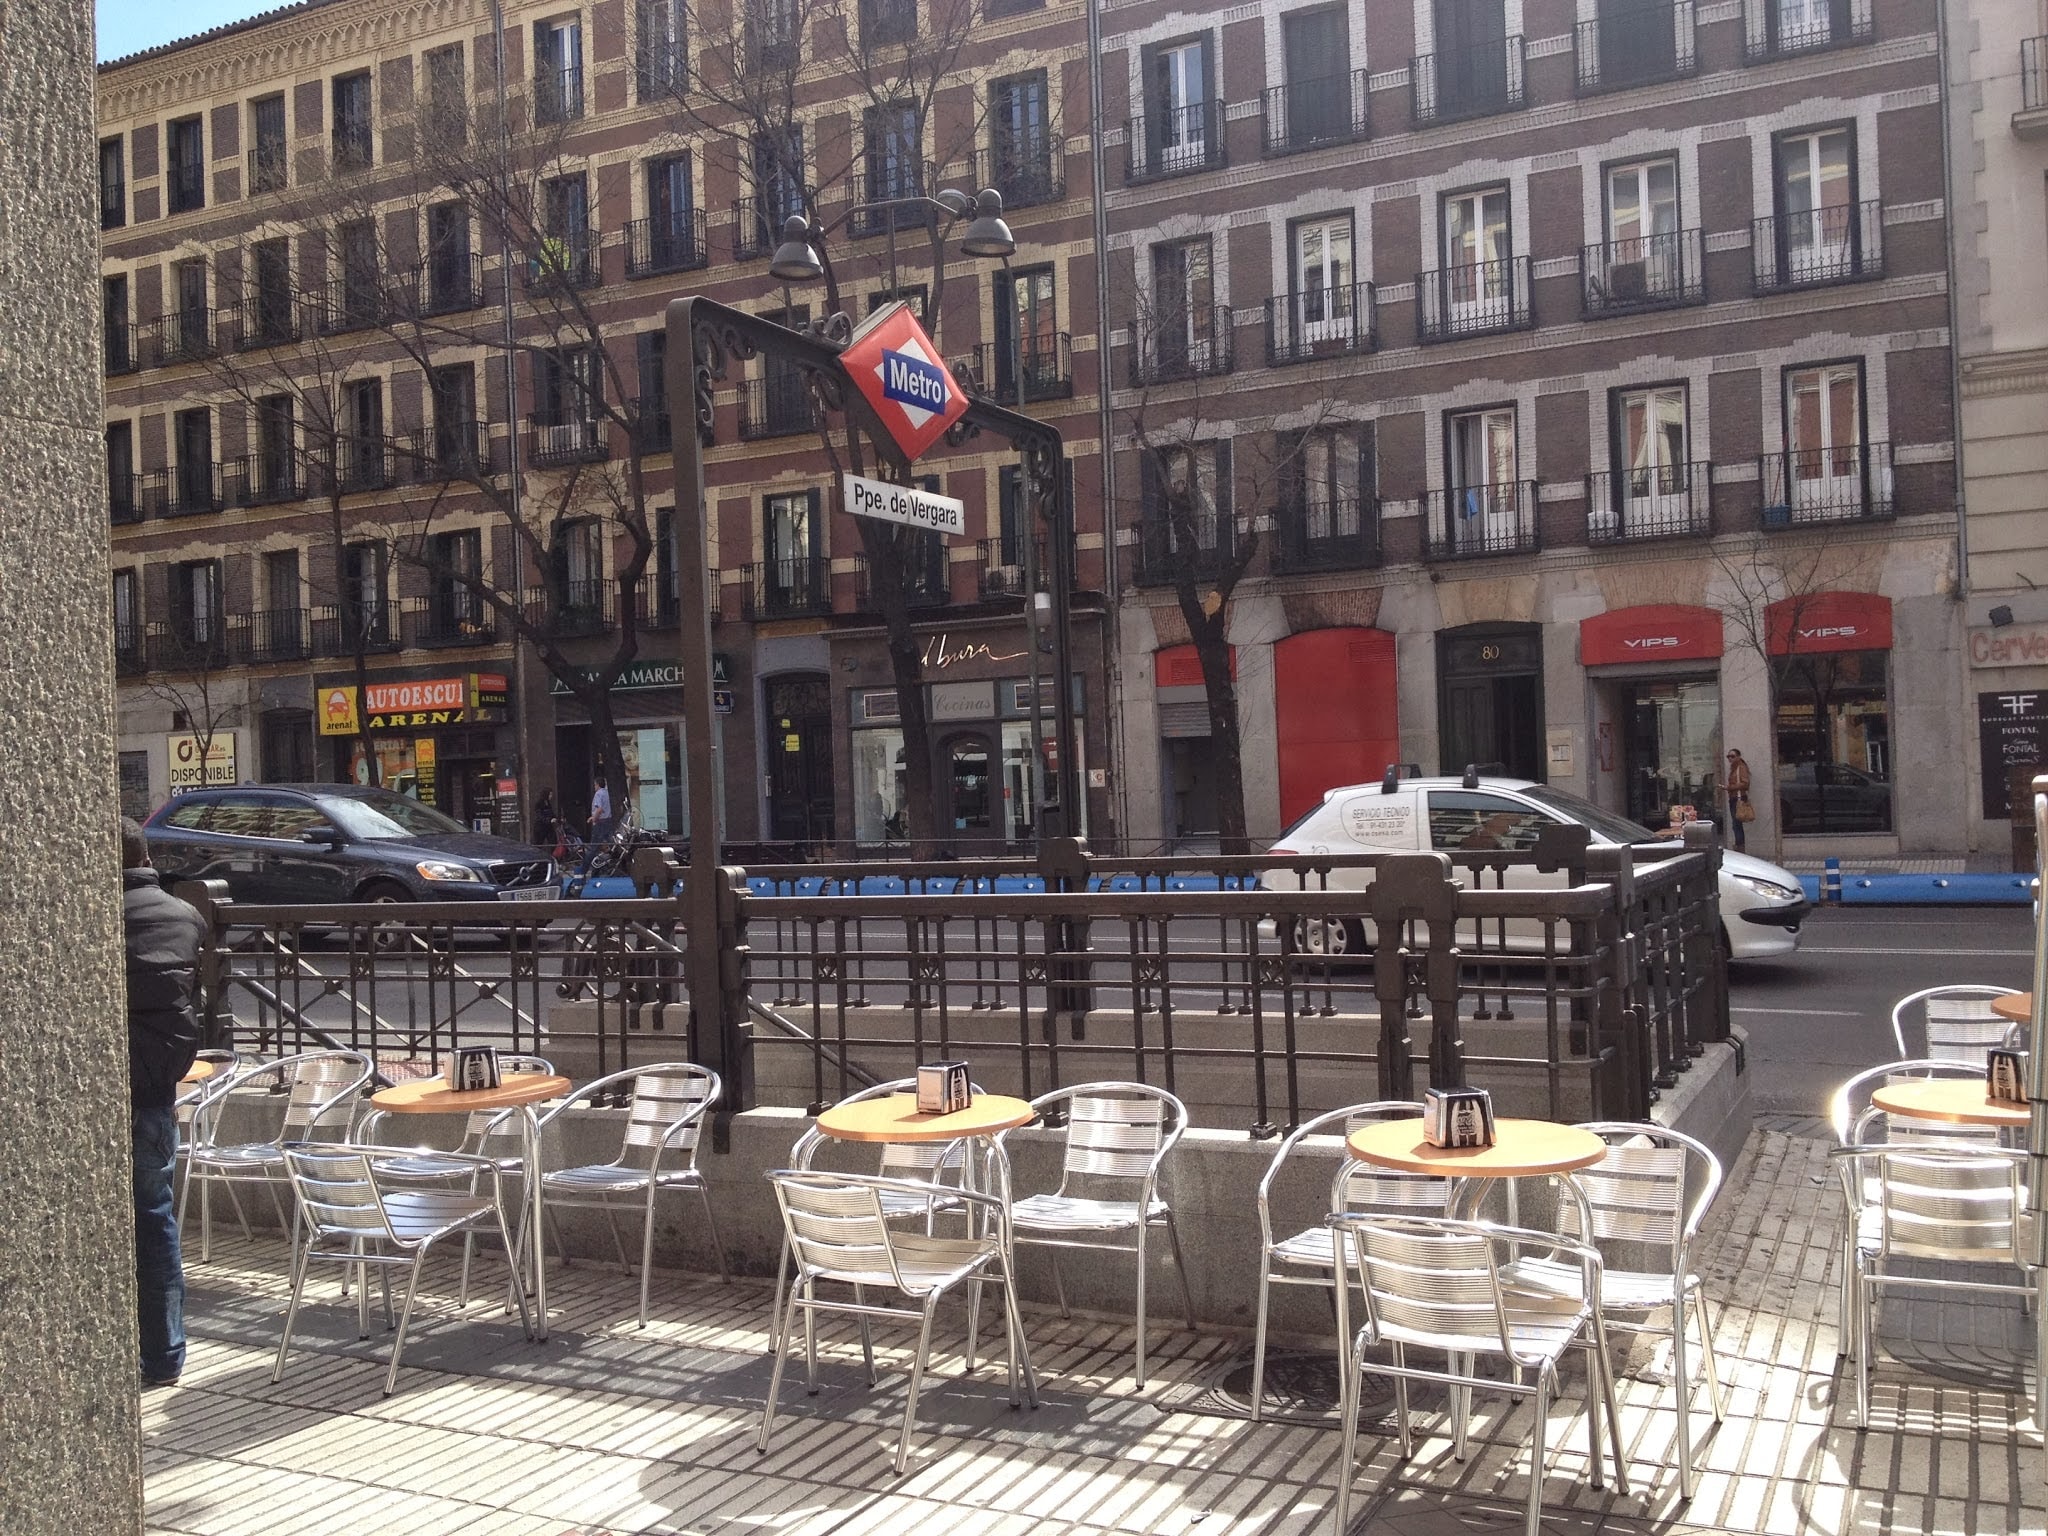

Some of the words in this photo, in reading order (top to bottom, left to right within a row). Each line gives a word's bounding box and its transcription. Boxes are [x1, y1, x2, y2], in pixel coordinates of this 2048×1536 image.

[890, 358, 941, 404] Metro
[854, 483, 886, 512] Ppe.
[890, 492, 907, 515] de
[910, 495, 957, 527] Vergara
[1799, 626, 1856, 638] VIPS
[1623, 636, 1679, 648] VIPS
[1482, 645, 1500, 660] 80
[631, 666, 685, 684] MARCH
[933, 692, 992, 712] Cocinas
[326, 720, 353, 730] arenal
[2001, 726, 2039, 735] FONTAL
[2002, 743, 2039, 754] FONTAL
[171, 766, 234, 783] DISPONIBLE
[1352, 808, 1381, 819] SERVICIO
[1383, 806, 1410, 818] TECNICO
